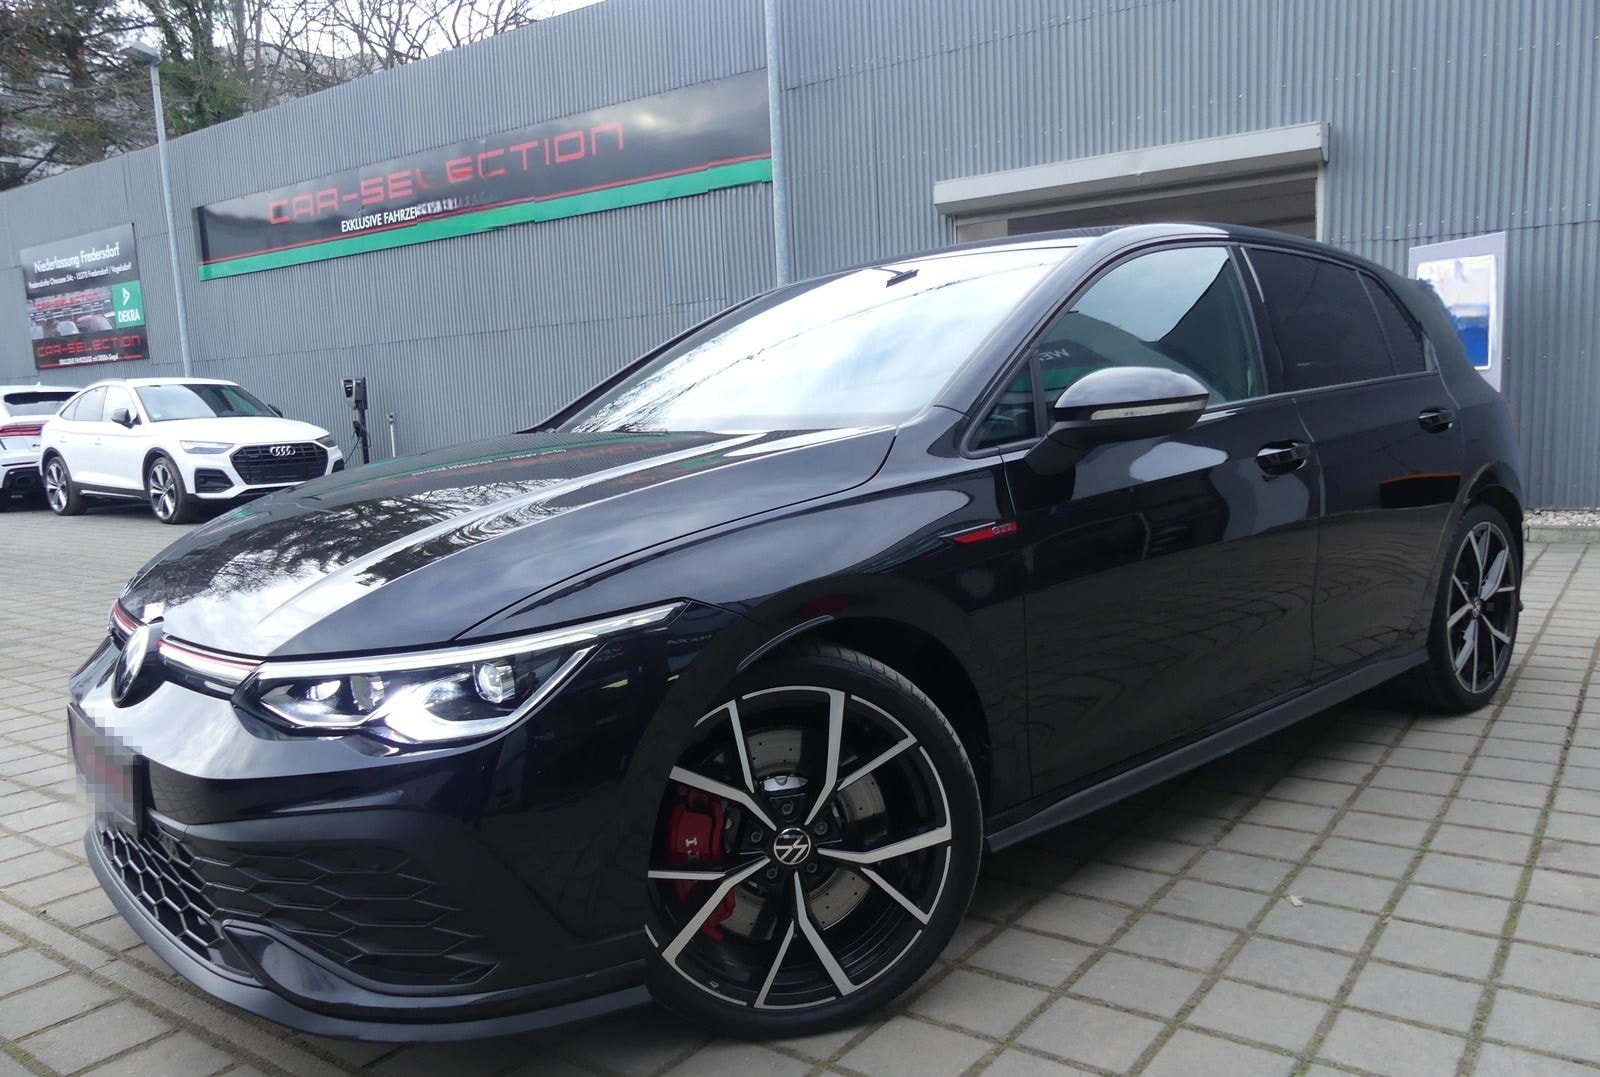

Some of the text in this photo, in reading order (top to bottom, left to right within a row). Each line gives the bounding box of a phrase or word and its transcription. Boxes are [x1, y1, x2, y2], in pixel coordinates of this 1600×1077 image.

[268, 121, 625, 226] CAR-SELECTION
[341, 212, 383, 233] EXKLUSIVE
[33, 242, 120, 273] Niederlassung Fredersdorf
[117, 308, 141, 324] DEKRA
[37, 335, 141, 357] CAR-SELECTION
